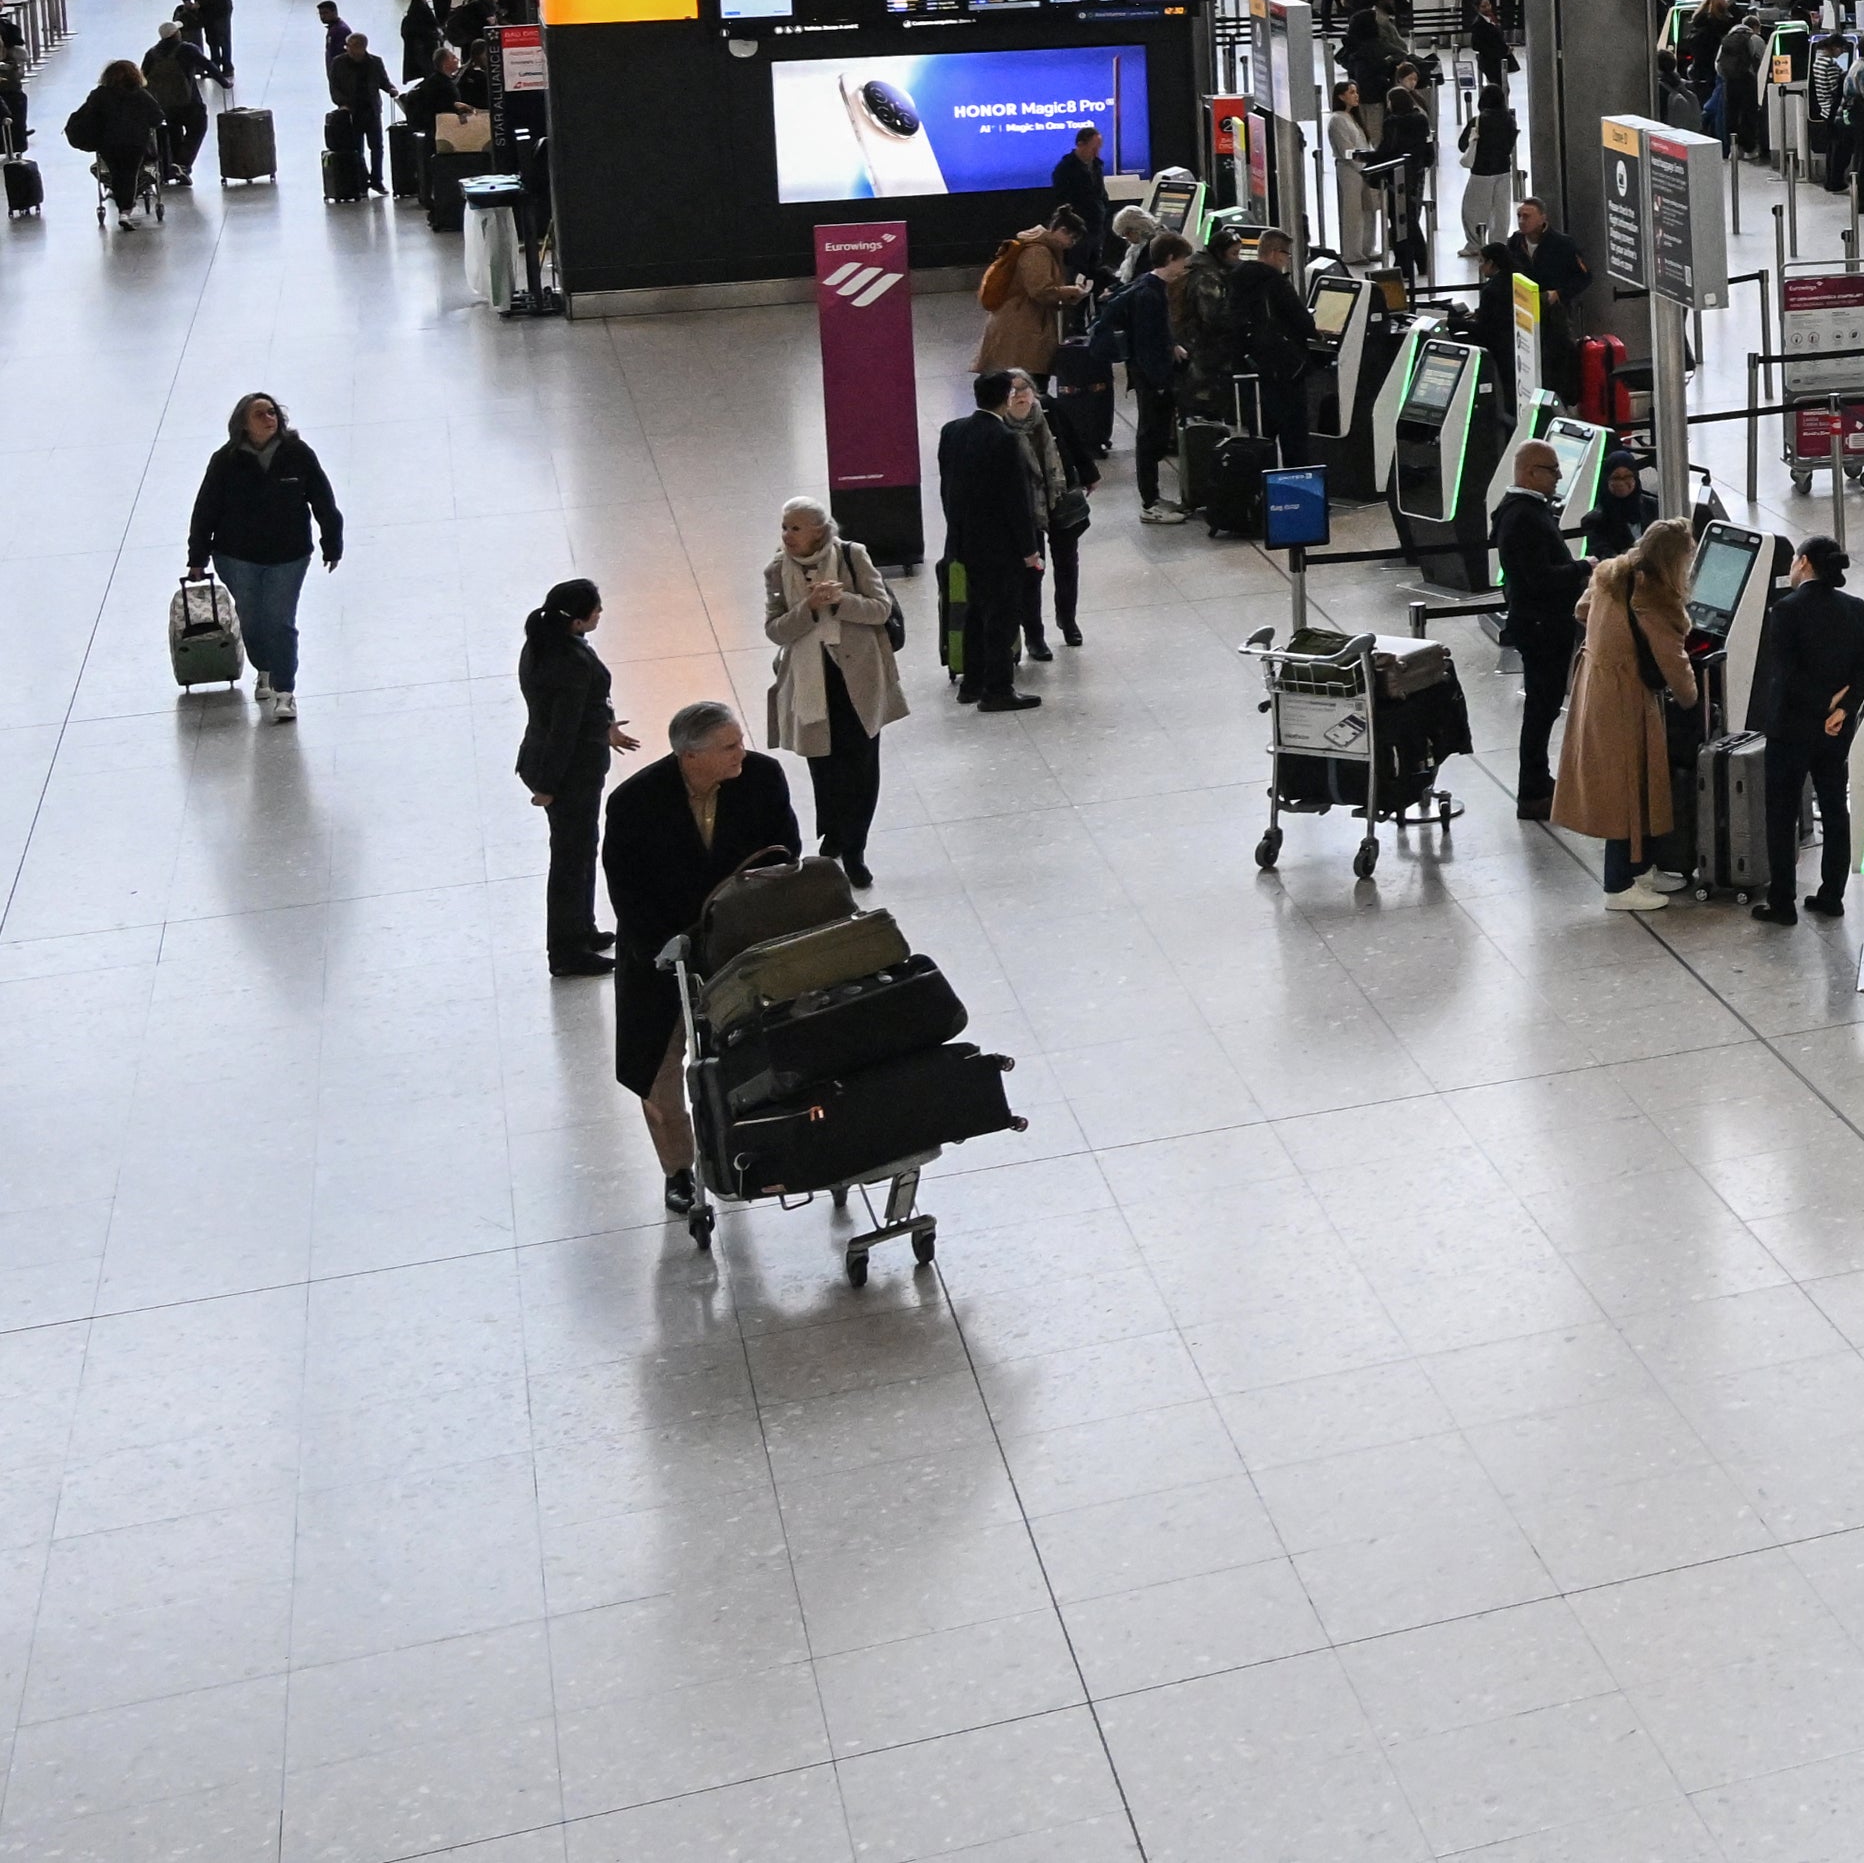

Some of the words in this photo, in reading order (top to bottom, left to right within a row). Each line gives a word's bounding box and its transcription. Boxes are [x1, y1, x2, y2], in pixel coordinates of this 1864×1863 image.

[954, 102, 1016, 118] HONOR
[1022, 101, 1076, 114] Magic8
[1080, 100, 1104, 112] Pro
[1006, 122, 1034, 133] Magic
[1046, 121, 1065, 131] One
[1067, 119, 1094, 129] Touch
[825, 240, 883, 252] Eurowings
